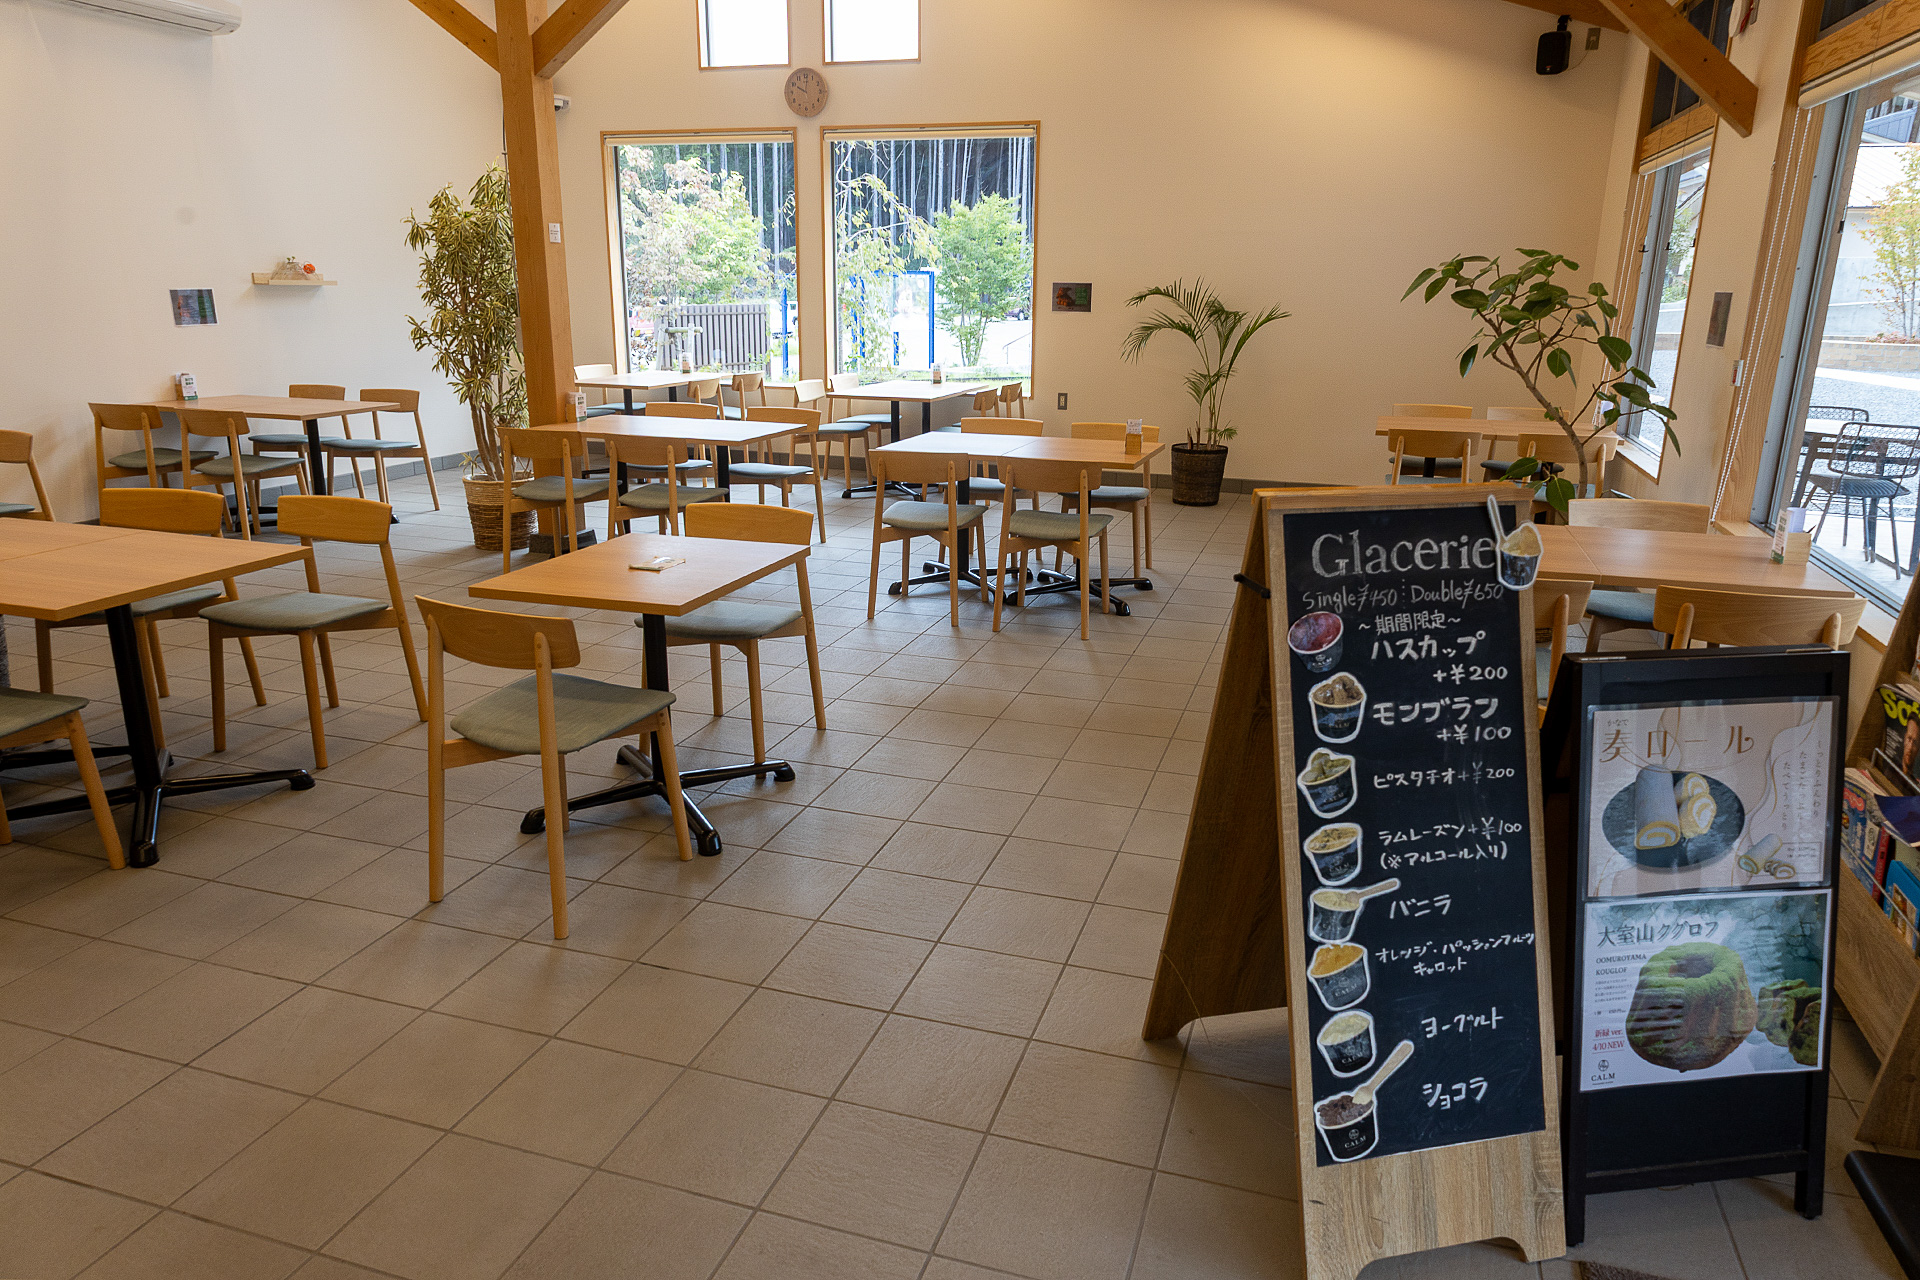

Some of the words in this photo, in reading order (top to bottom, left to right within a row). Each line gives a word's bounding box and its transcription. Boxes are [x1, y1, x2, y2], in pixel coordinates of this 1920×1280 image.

[1311, 529, 1497, 578] Glacerie
[1371, 630, 1486, 660] ハスカップ
[1433, 663, 1508, 685] +¥200
[1372, 696, 1499, 726] モンブラン
[1436, 724, 1512, 745] +¥100
[1389, 893, 1451, 920] バニラ
[1597, 920, 1720, 948] 大室山クグロフ
[1413, 956, 1468, 977] キャロット
[1596, 953, 1647, 964] OOMUROYAMA
[1595, 966, 1628, 975] KOUGLOF
[1421, 1006, 1505, 1039] ヨーグルト
[1611, 1028, 1624, 1036] ver.
[1592, 1042, 1607, 1051] 4/10
[1608, 1040, 1625, 1049] NEW
[1591, 1072, 1615, 1082] CALM
[1422, 1076, 1489, 1110] ショコラ
[1344, 1135, 1367, 1148] CALM
